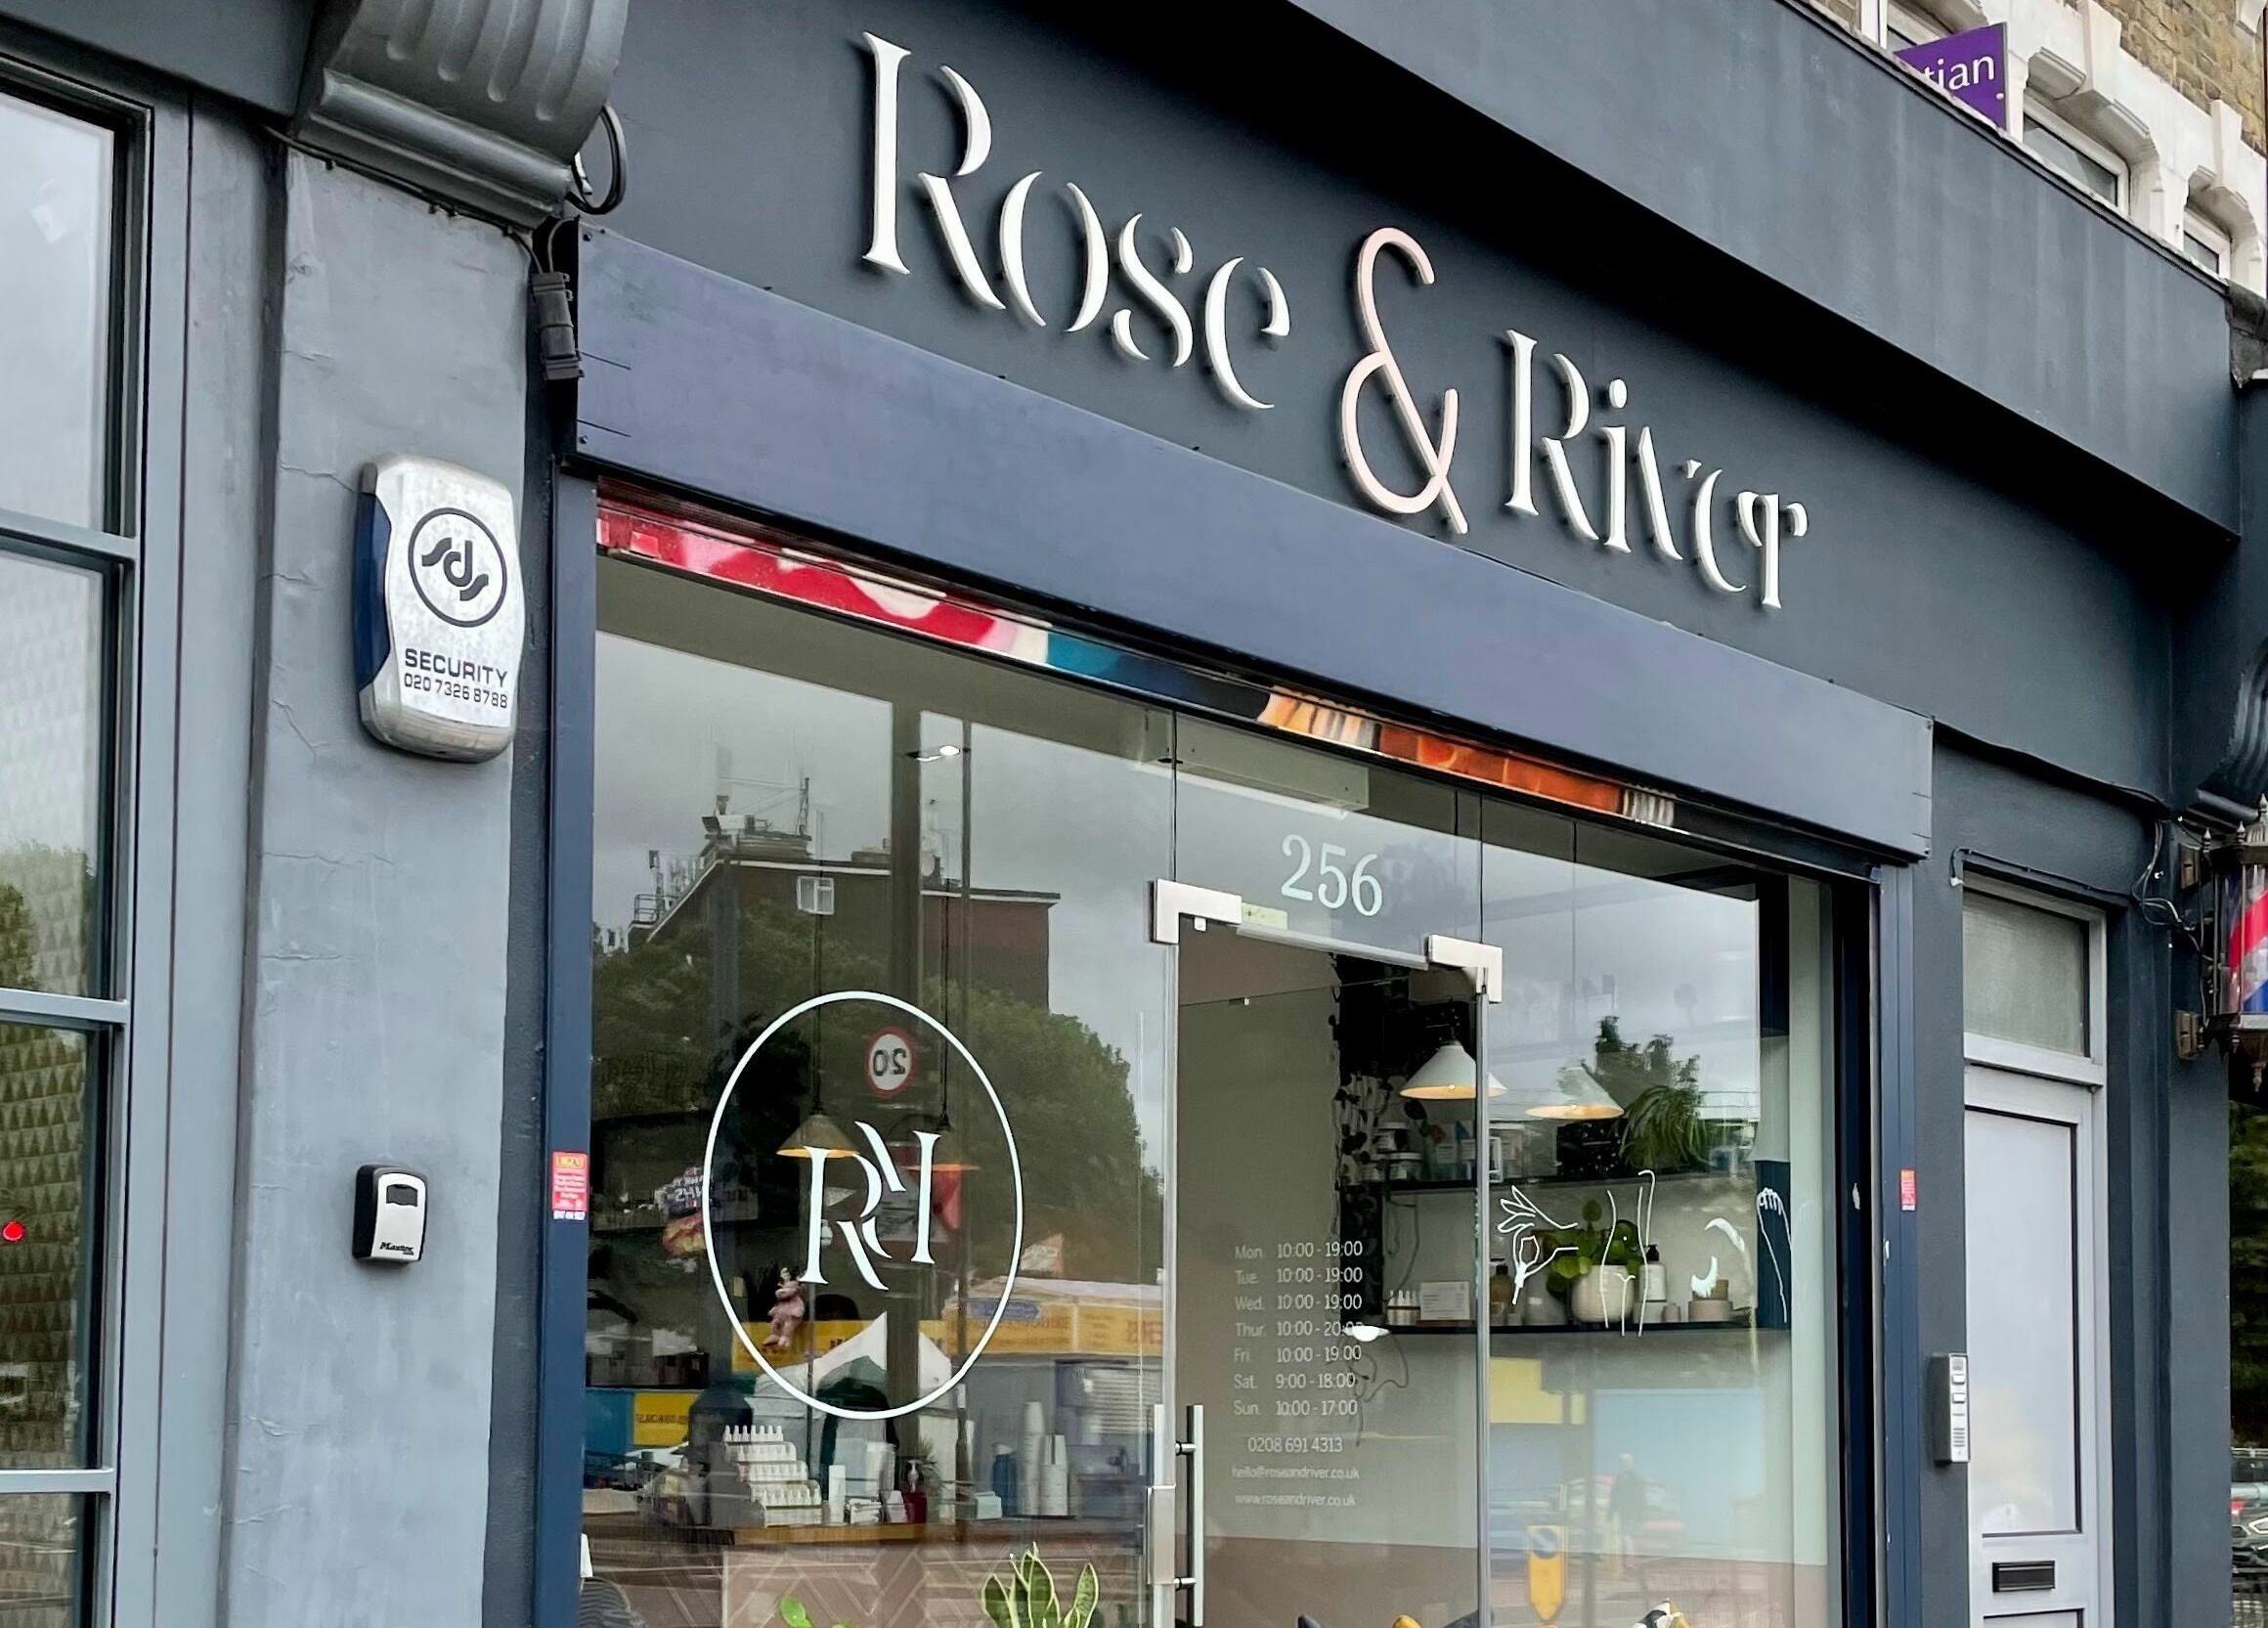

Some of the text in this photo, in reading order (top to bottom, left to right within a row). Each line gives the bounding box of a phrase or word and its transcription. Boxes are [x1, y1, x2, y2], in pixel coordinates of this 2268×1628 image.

[863, 31, 1808, 609] Rose & River
[405, 647, 508, 688] SECURITY
[404, 672, 508, 710] 020 7326 8788
[1281, 833, 1383, 917] 256
[1277, 1242, 1314, 1258] 10:00
[1277, 1267, 1314, 1283] 10:00
[1277, 1294, 1314, 1310] 10:00
[1277, 1321, 1313, 1337] 10:00
[1277, 1347, 1313, 1363] 10:00
[1276, 1373, 1307, 1388] 9:00
[1276, 1400, 1311, 1416] 10:00
[1247, 1436, 1343, 1453] 0208 691 4313
